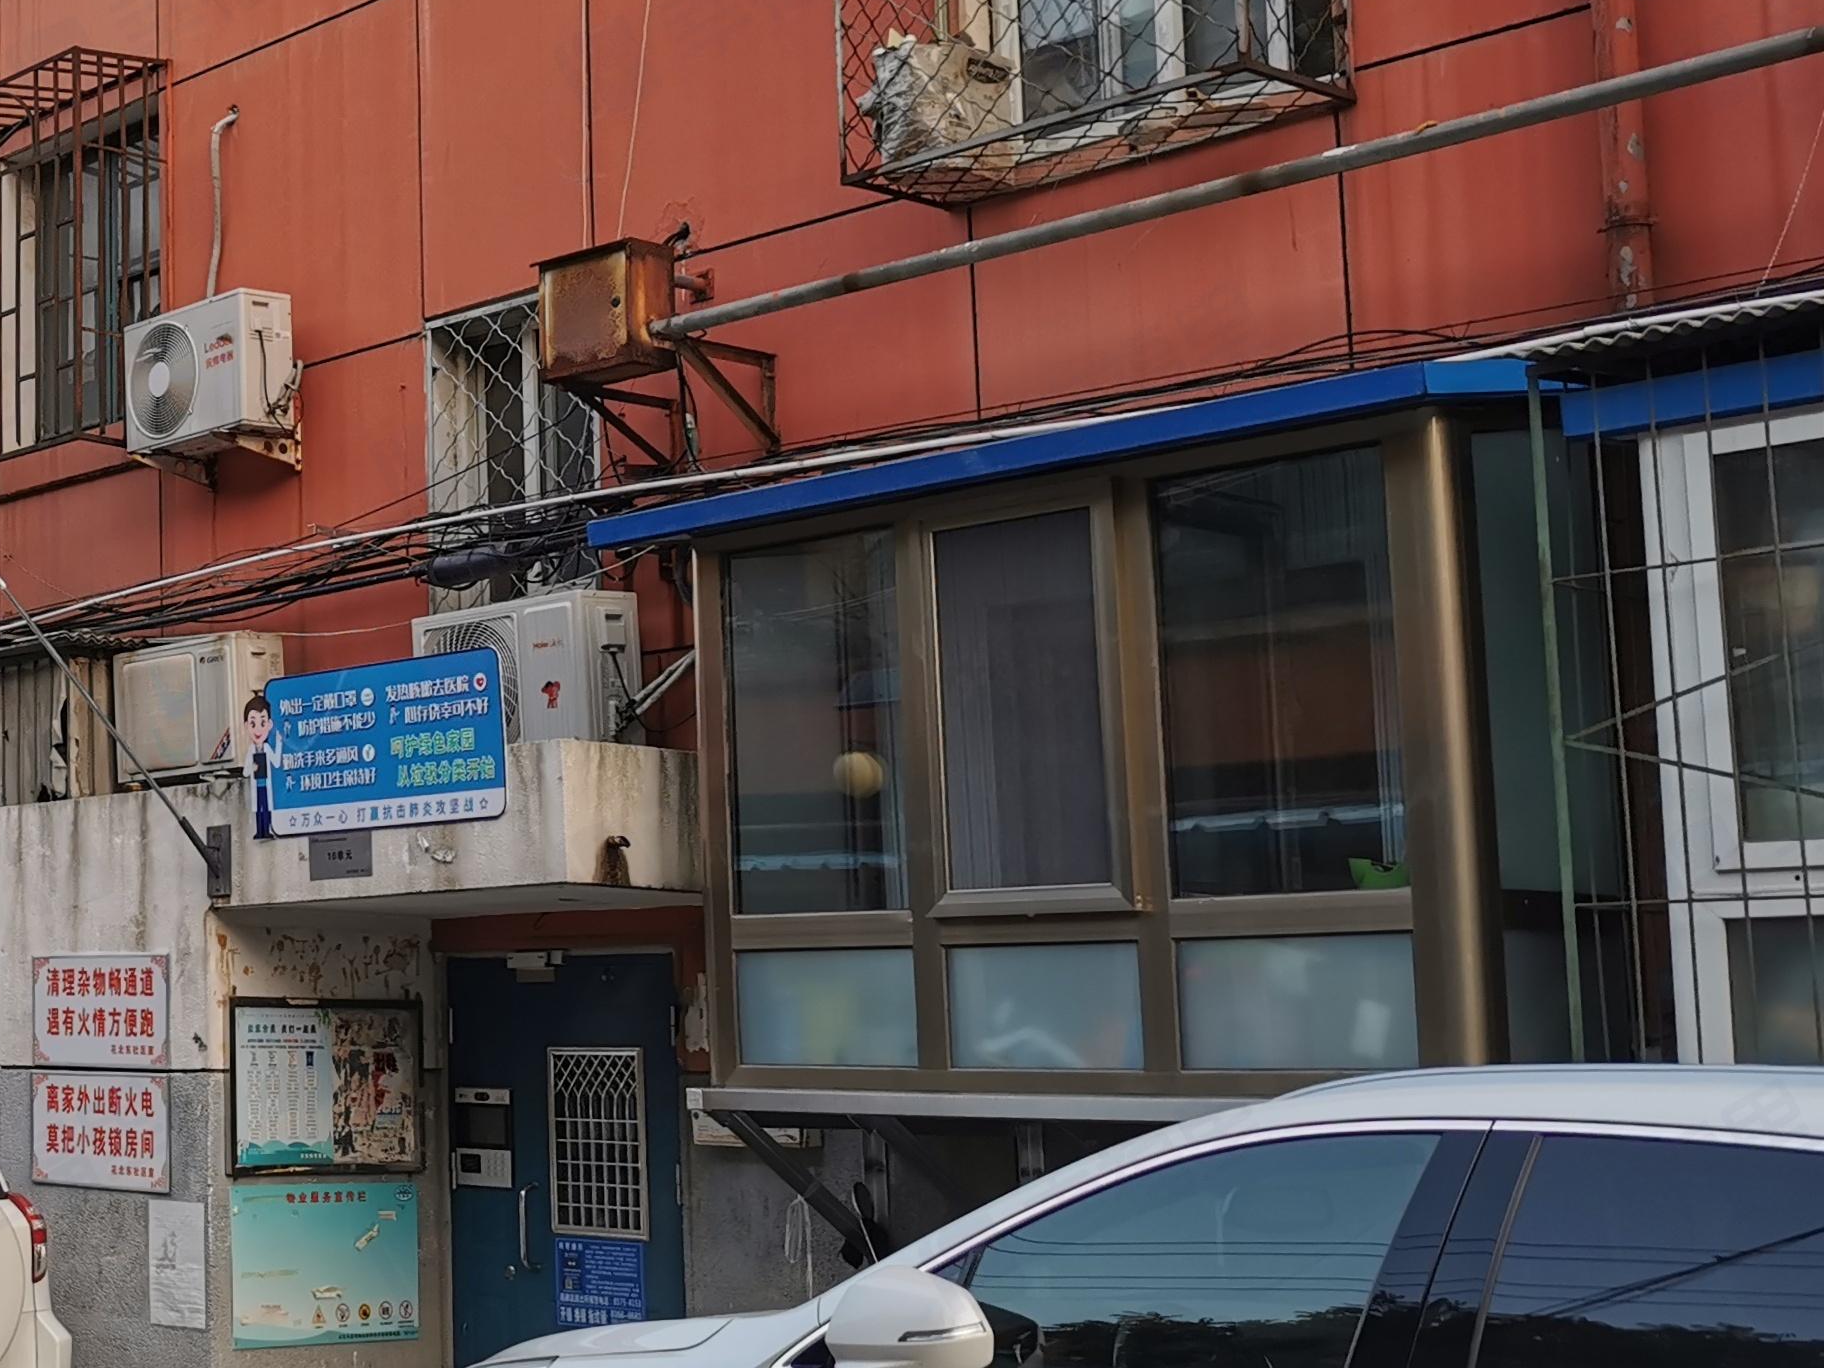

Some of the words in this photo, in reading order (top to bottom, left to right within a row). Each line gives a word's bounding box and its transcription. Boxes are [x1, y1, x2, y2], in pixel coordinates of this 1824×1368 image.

[298, 711, 376, 737] 防护措施不能少
[397, 755, 496, 787] 从垃圾分类开始
[46, 967, 154, 997] 清理杂物畅通道
[46, 1007, 154, 1037] 遇有火情方便跑
[46, 1083, 154, 1117] 离家外出断火电
[46, 1123, 154, 1159] 莫把小孩锁房间
